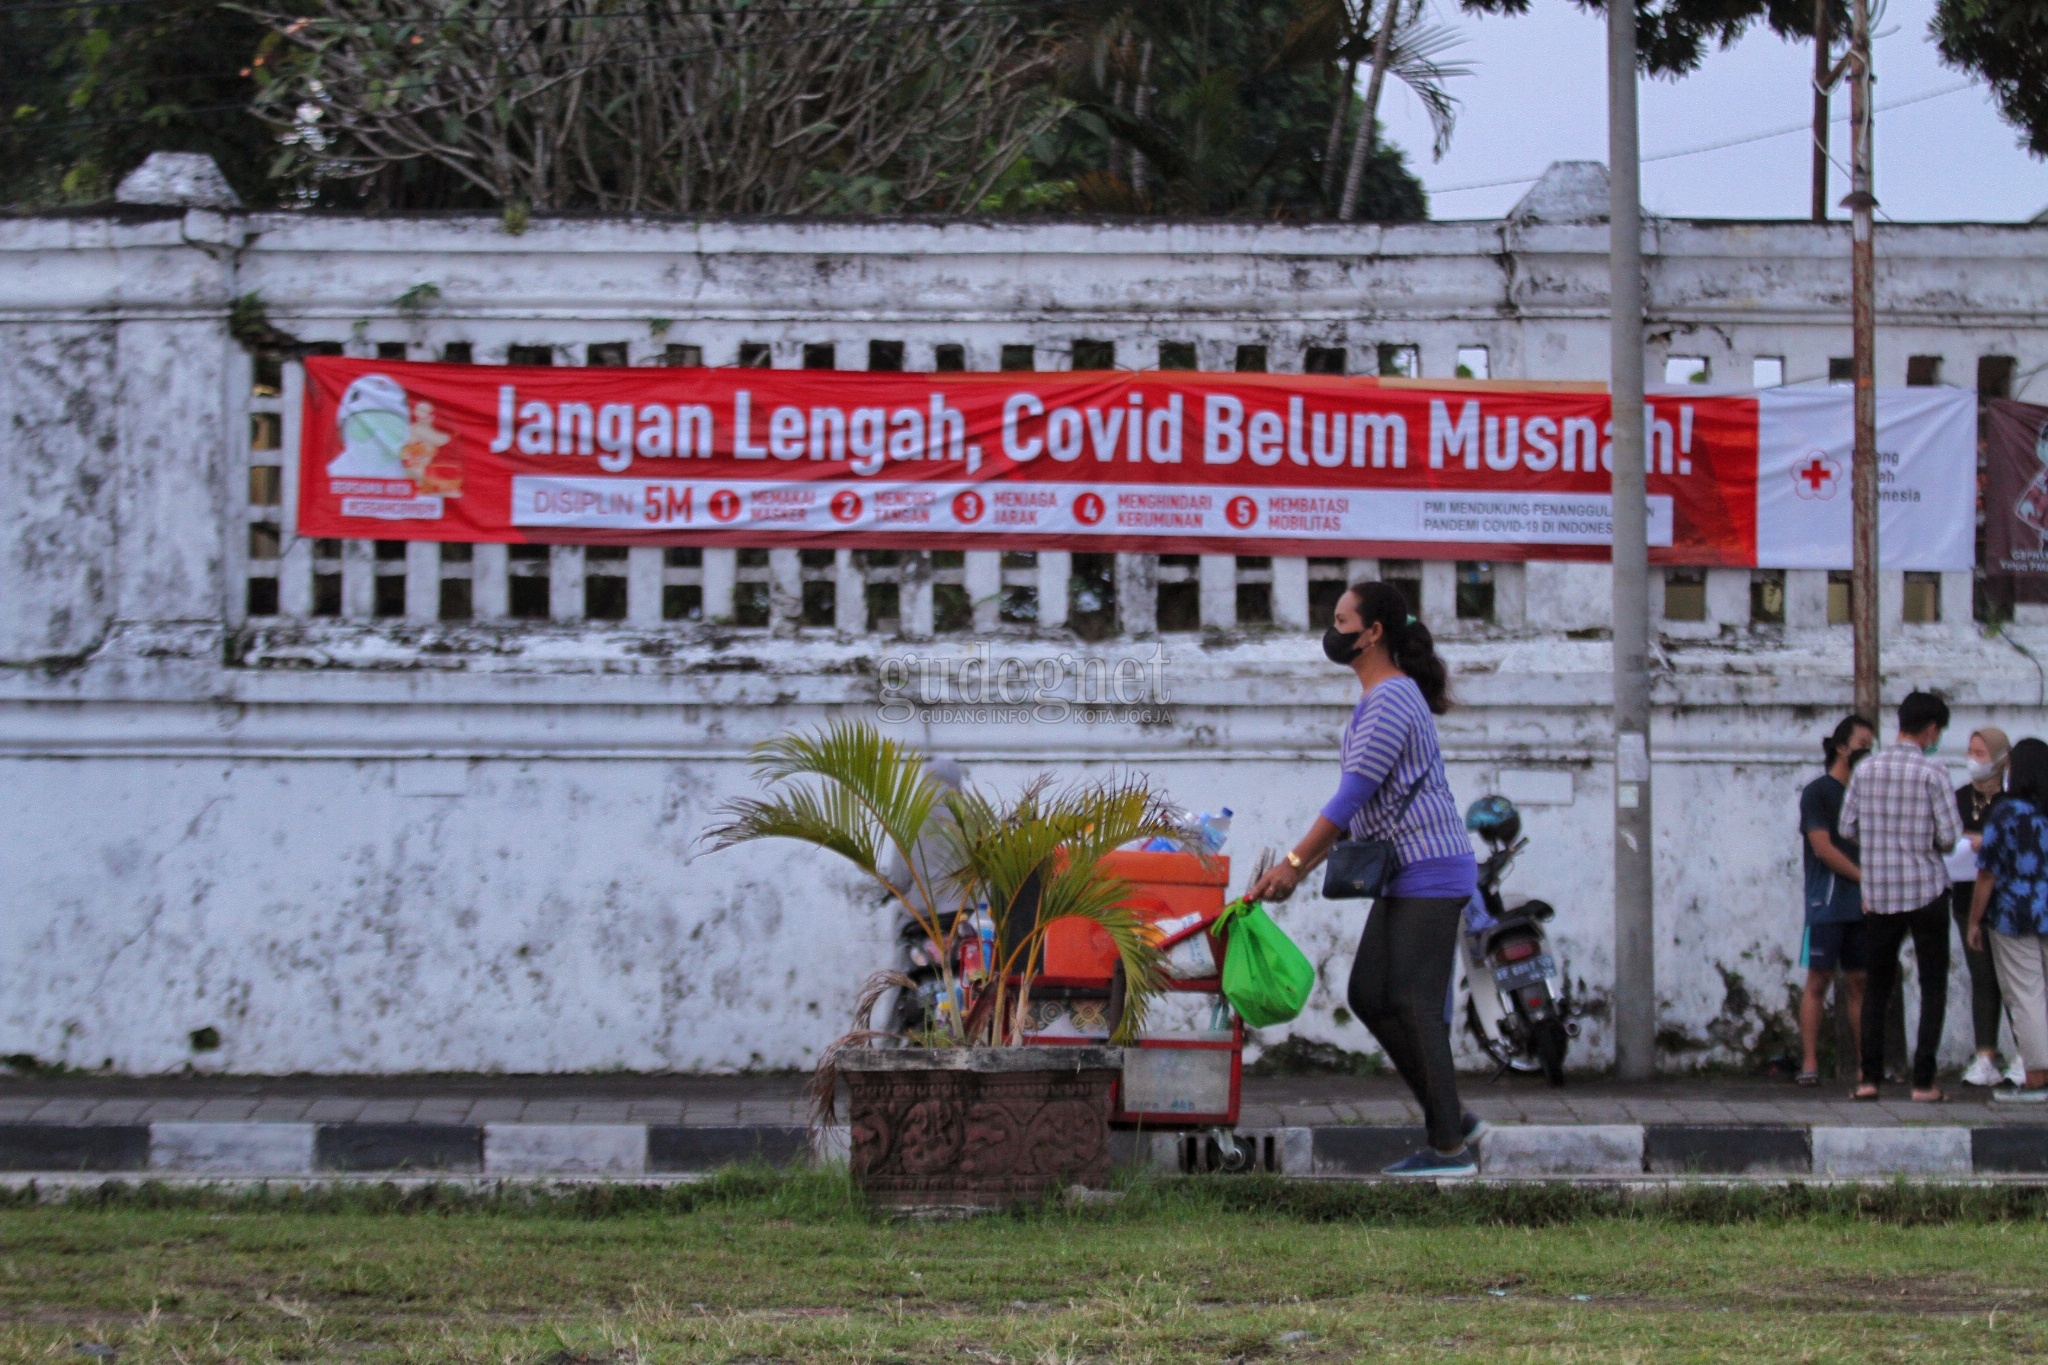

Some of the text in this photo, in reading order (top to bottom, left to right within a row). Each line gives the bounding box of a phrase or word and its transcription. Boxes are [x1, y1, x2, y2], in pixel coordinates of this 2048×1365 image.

[490, 385, 713, 472] Jangan
[734, 390, 982, 476] Lengah,
[1002, 392, 1182, 463] Covid
[1204, 393, 1407, 469] Belum
[534, 486, 692, 522] DISIPLIN 5M
[994, 492, 1057, 507] MENJAGA
[1118, 494, 1213, 511] MENGHINDARI
[1268, 498, 1349, 514] MEMBATASI
[993, 510, 1037, 525] JARAK
[1424, 501, 1655, 519] PMI MENDUKUNG PENANGGULN
[1118, 511, 1203, 528] KERUMUNAN
[1268, 515, 1341, 532] MOBILITAS
[1424, 518, 1613, 535] PANDEMI COVID-19 DI INDONES
